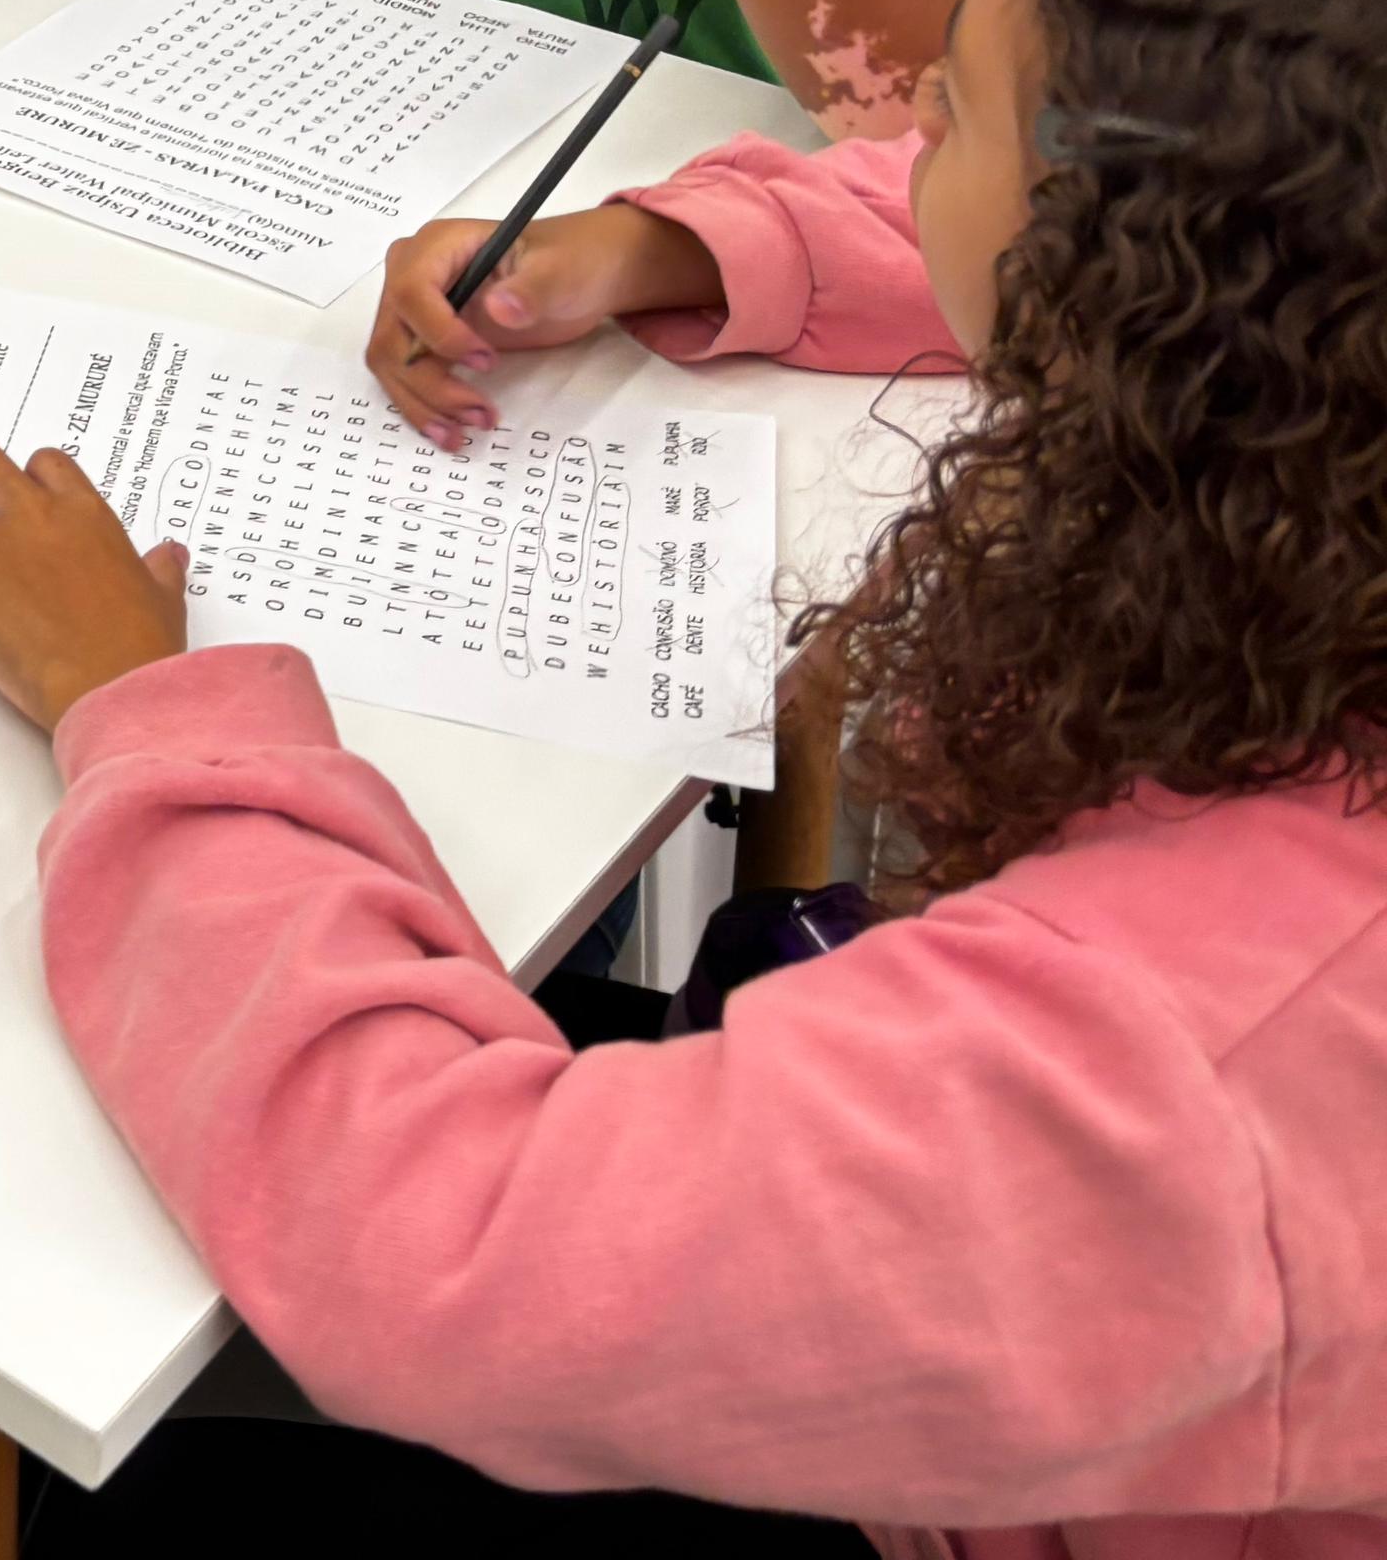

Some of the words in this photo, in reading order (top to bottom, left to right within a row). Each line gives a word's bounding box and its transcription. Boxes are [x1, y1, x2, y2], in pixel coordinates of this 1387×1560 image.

[13, 105, 112, 146] MURURÉ
[85, 107, 142, 138] vertical
[159, 131, 229, 165] horizontal
[238, 141, 296, 170] história
[39, 157, 105, 193] Walter
[154, 151, 270, 196] PALAVRAS
[256, 162, 321, 193] palavras
[319, 168, 402, 204] presentes
[61, 183, 139, 220] Usipaz
[108, 184, 211, 230] Municipal
[270, 187, 335, 217] CAÇA
[341, 191, 400, 219] Circule
[146, 212, 267, 263] Biblioteca
[212, 219, 296, 254] Escola
[248, 212, 334, 249] Aluno(a)
[141, 332, 164, 371] estavam
[76, 352, 113, 413] MURURÉ
[134, 372, 153, 391] que
[68, 412, 88, 434] ZÉ
[124, 392, 144, 426] vertical
[100, 436, 129, 490] horizontal
[131, 475, 147, 490] do
[152, 408, 170, 427] que
[692, 486, 711, 522] PORCO
[658, 541, 677, 588] DOMINÓ
[686, 540, 708, 595] HISTÓRIA
[652, 598, 675, 661] CONFUSÃO
[685, 615, 705, 655] DENTE
[651, 672, 671, 719] CACHO
[679, 685, 705, 719] CAFÉ
